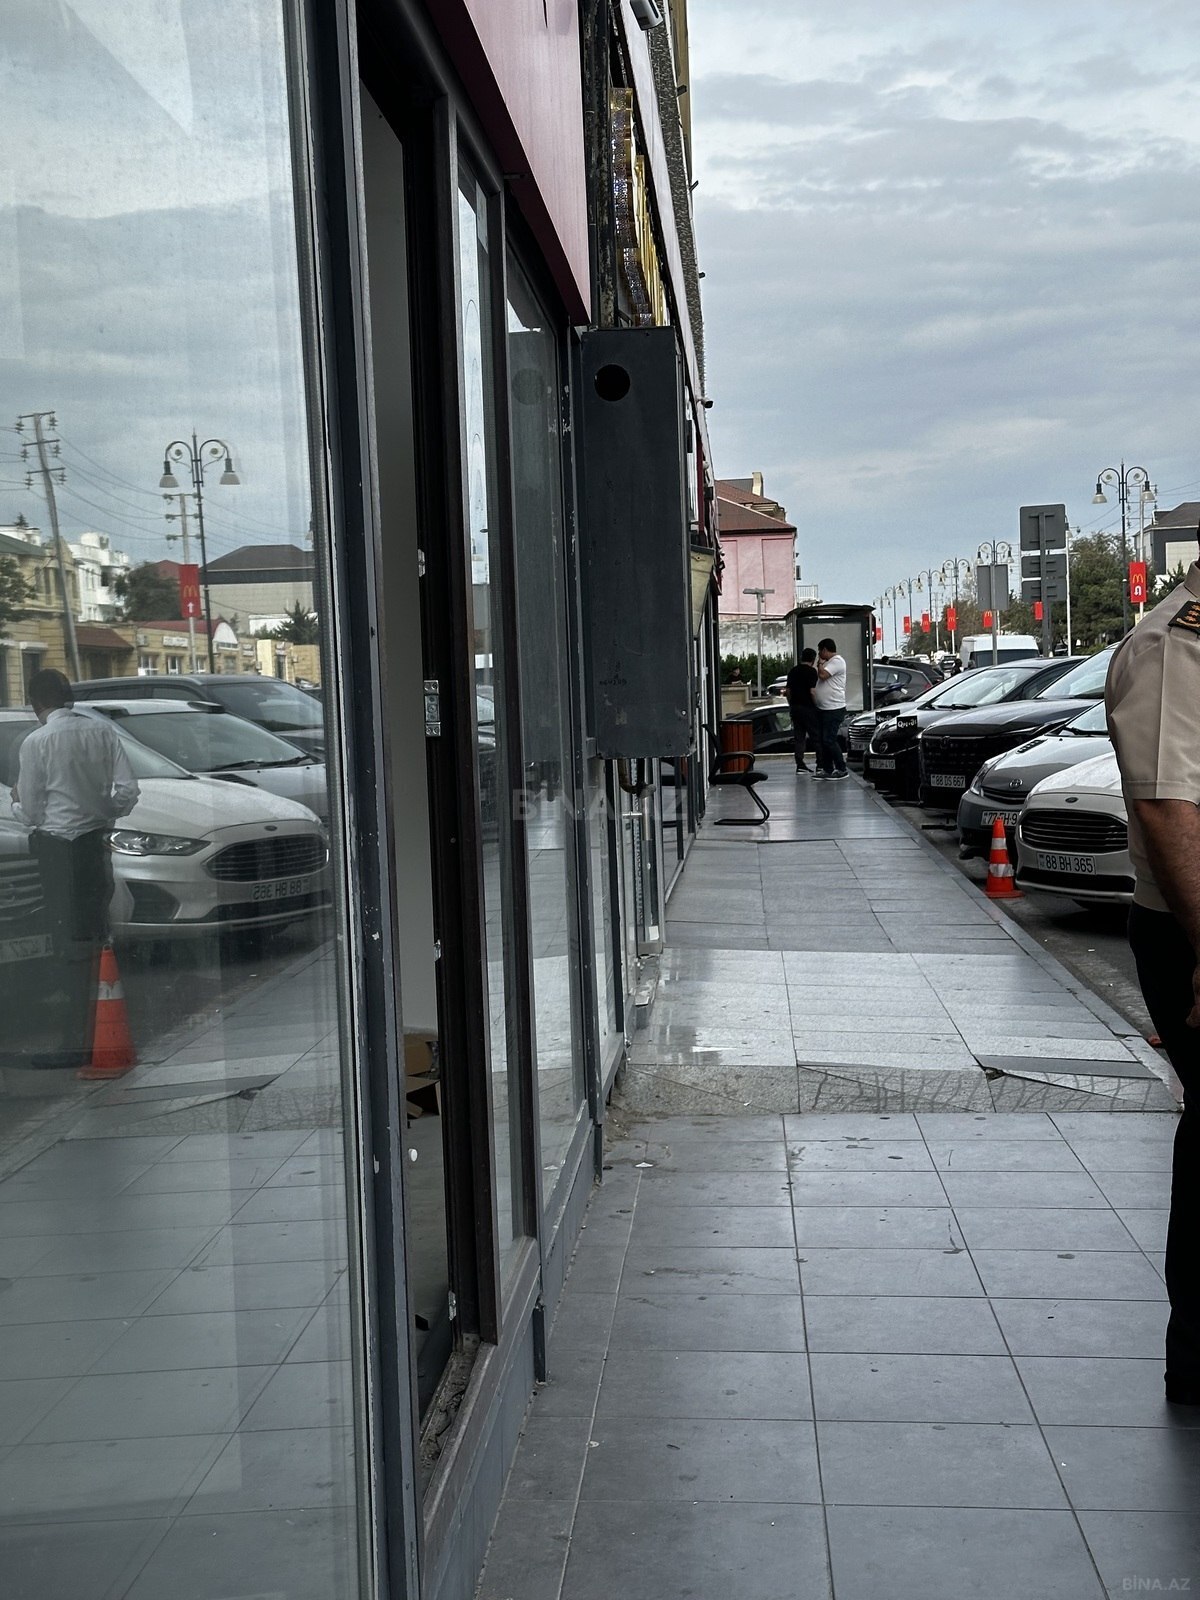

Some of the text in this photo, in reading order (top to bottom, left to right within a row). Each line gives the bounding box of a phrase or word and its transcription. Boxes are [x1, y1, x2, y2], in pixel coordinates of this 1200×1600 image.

[1045, 854, 1093, 873] 88 BH 365
